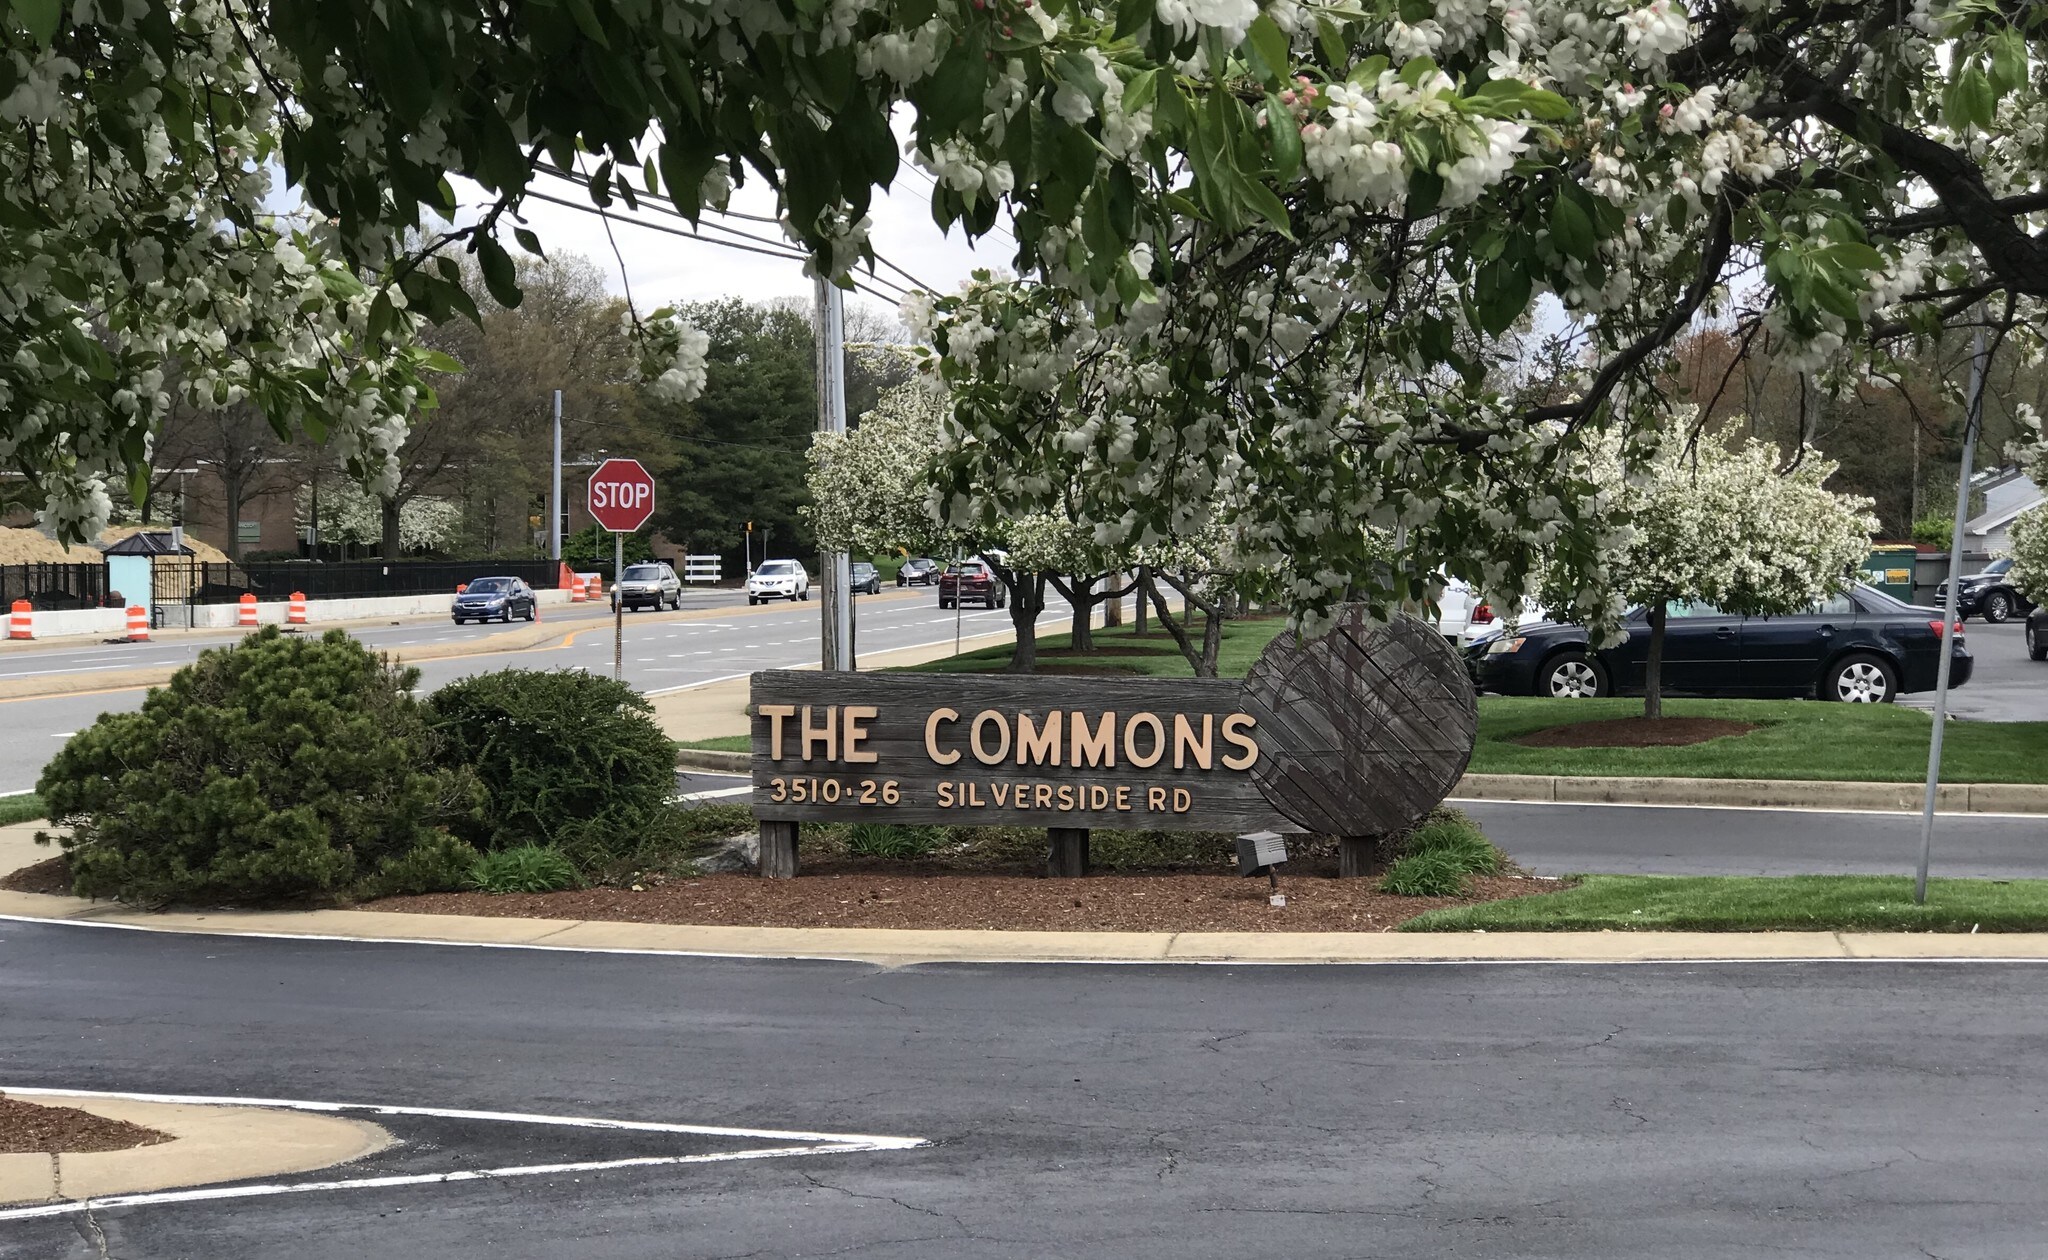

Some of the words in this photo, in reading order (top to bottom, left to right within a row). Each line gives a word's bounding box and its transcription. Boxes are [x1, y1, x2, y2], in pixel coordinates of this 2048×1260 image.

[593, 481, 650, 509] STOP
[758, 704, 879, 764] THE
[924, 706, 1260, 772] COMMONS
[936, 781, 1133, 812] SILVERSIDE
[1147, 786, 1193, 813] RD
